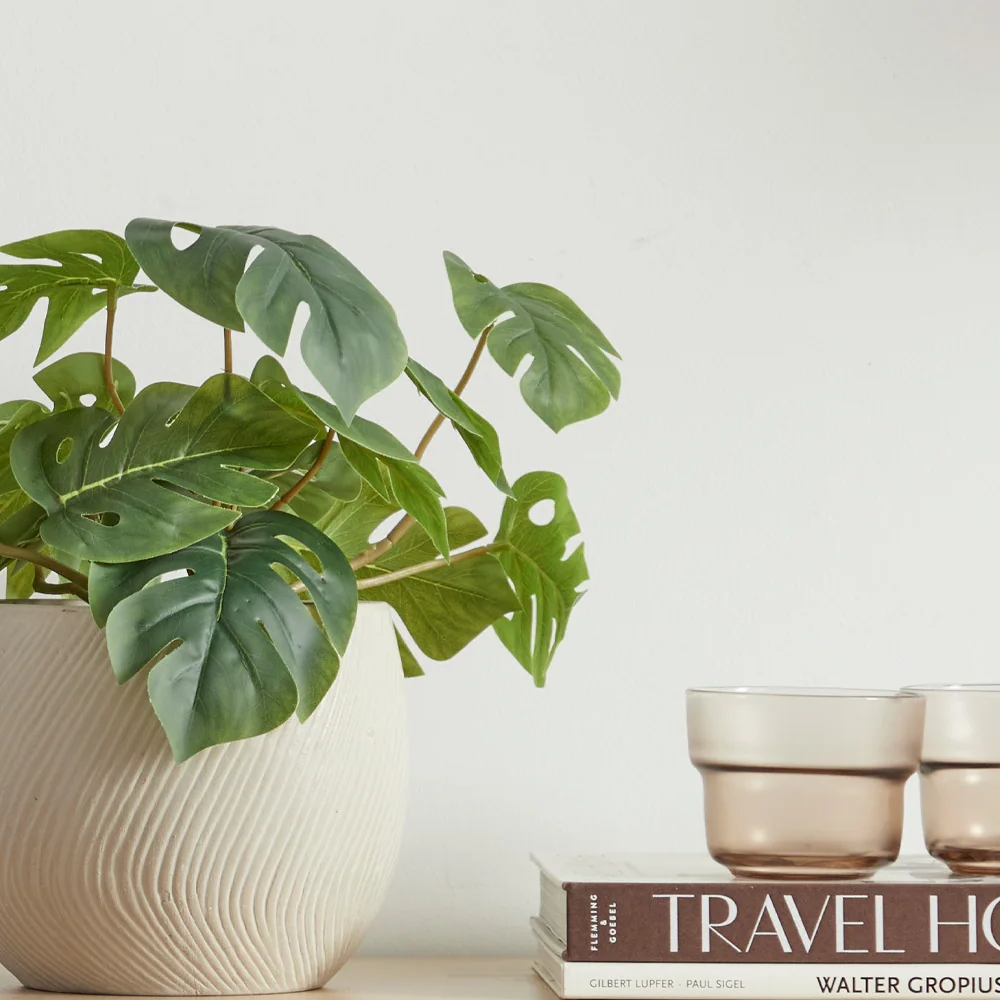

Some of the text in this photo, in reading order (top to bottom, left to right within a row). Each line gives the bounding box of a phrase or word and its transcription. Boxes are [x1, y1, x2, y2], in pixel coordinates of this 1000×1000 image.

[590, 895, 598, 951] FLEMMING
[608, 902, 617, 944] GOEBEL
[652, 894, 905, 953] TRAVEL
[589, 978, 745, 989] GILBERT LUPFER PAUL SIGEL
[817, 977, 899, 993] WALTER
